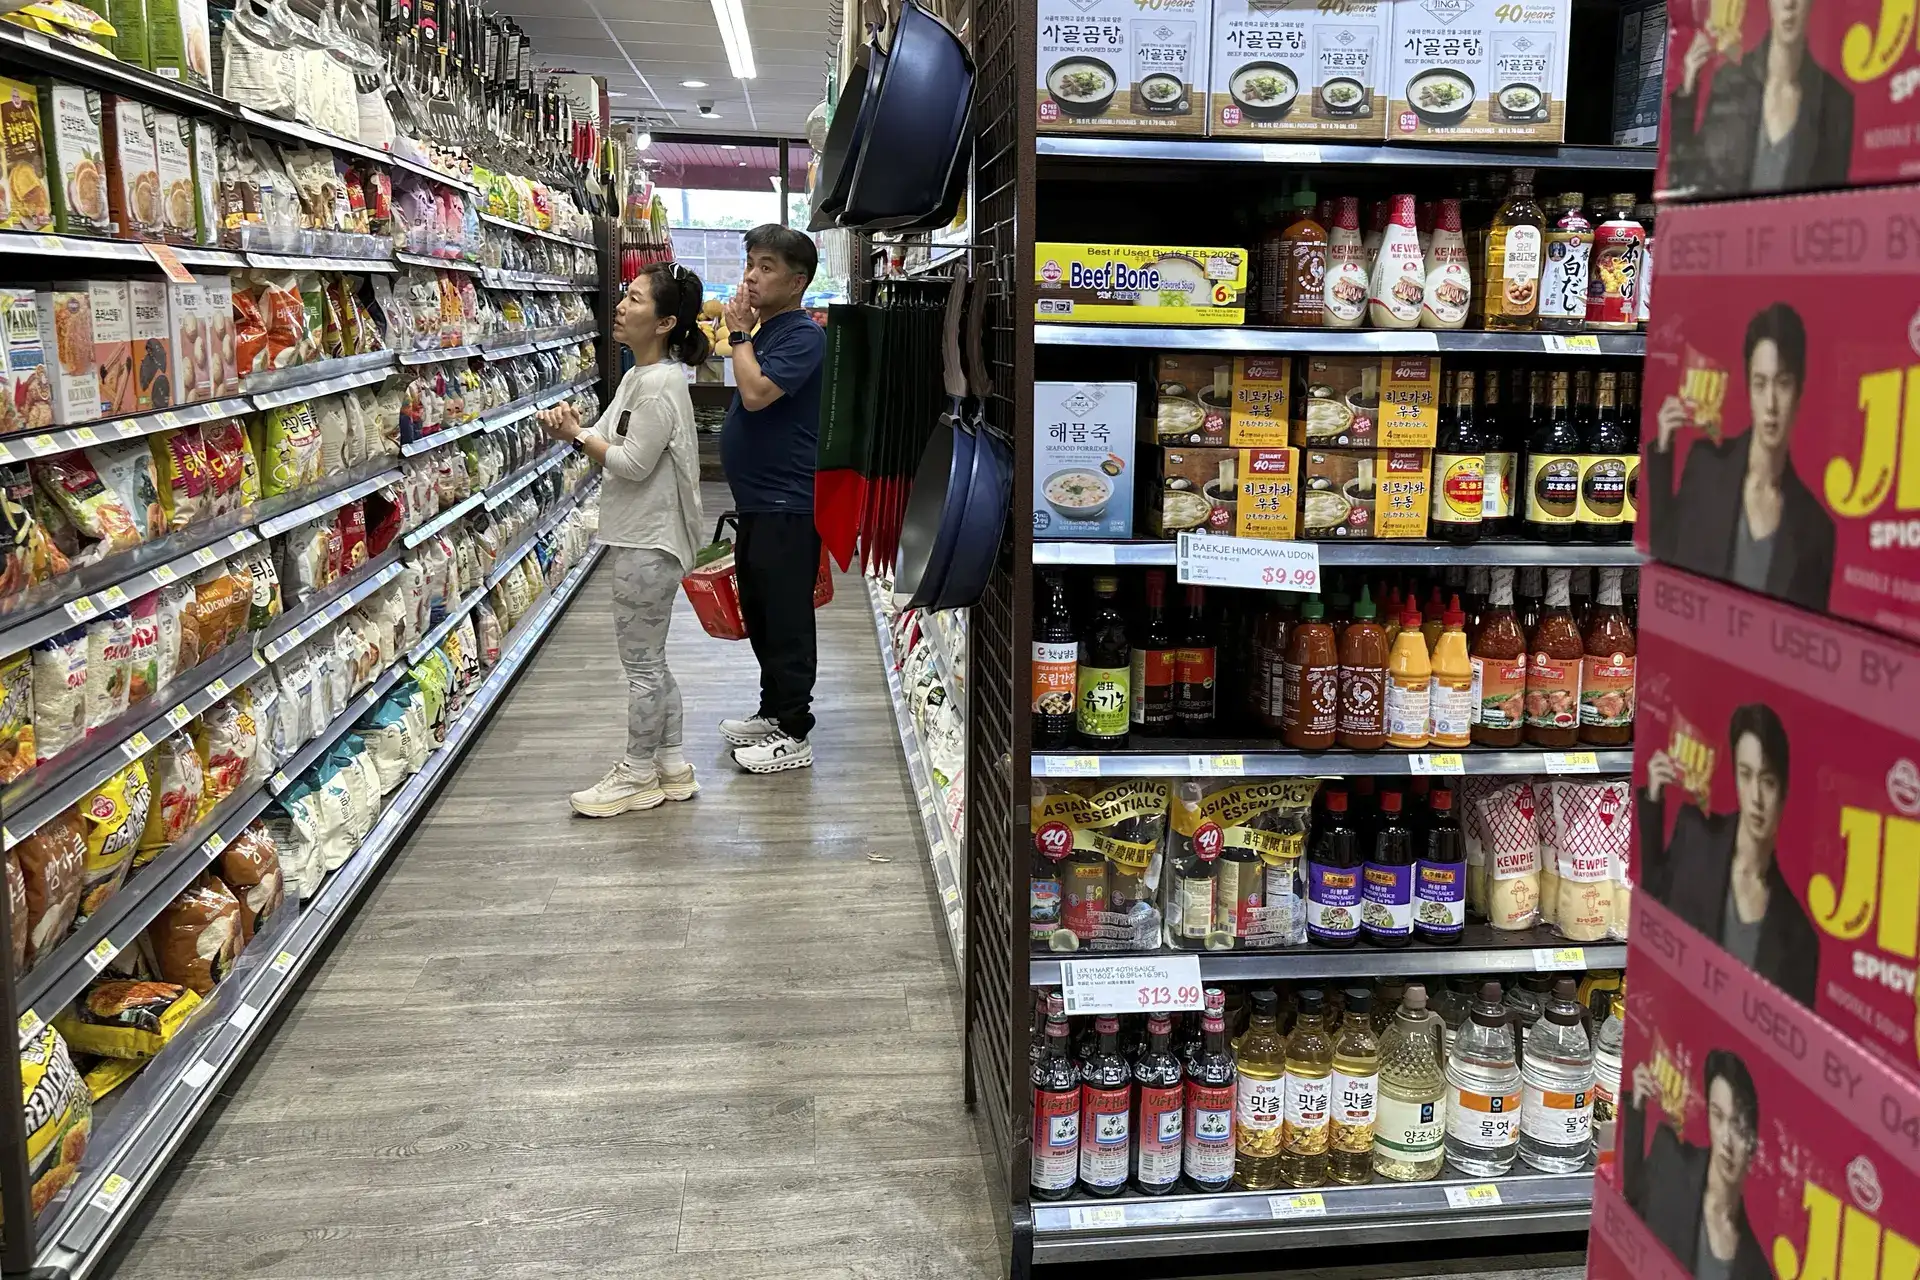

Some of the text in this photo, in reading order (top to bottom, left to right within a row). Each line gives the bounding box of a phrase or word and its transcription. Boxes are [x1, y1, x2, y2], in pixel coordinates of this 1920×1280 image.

[1345, 4, 1378, 16] years
[1434, 0, 1460, 8] JINGA
[1494, 4, 1556, 24] 40 years
[1043, 25, 1121, 45] 사골곰탕
[1227, 30, 1304, 49] 사골곰탕
[1404, 38, 1480, 57] 사골곰탕
[1138, 49, 1188, 61] 사골곰탕
[1320, 53, 1370, 65] 사골곰탕
[1497, 59, 1546, 71] 사골곰탕
[1041, 104, 1047, 115] 6
[1223, 108, 1230, 120] 6
[1400, 115, 1407, 126] 6
[1516, 242, 1532, 250] 요리
[1668, 212, 1920, 271] BEST IF USED BY
[1087, 247, 1110, 256] Best
[1113, 247, 1121, 256] if
[1122, 248, 1150, 258] Used
[1152, 250, 1165, 259] By
[1168, 250, 1181, 258] 16
[1508, 252, 1537, 262] 올리고당
[1070, 261, 1160, 290] Beef Bone
[1161, 280, 1195, 292] Flavored Soup
[1561, 255, 1583, 312] 白だし
[1214, 286, 1226, 303] 6
[1248, 367, 1262, 377] 40
[1395, 368, 1409, 378] 40
[1239, 390, 1284, 404] 히모카와
[1386, 391, 1432, 404] 히모카와
[1070, 400, 1089, 408] JINGA
[1250, 404, 1273, 417] 우동
[1396, 405, 1420, 418] 우동
[1239, 420, 1280, 428] ひもかわうどん
[1387, 420, 1428, 428] ひもかわうどん
[1048, 421, 1111, 444] 해물죽
[1081, 445, 1109, 453] PORRIDGE
[1253, 460, 1268, 470] 40
[1390, 459, 1403, 470] 40
[1245, 483, 1292, 496] 히모카와
[1382, 481, 1425, 494] 히모카와
[1256, 498, 1280, 511] 우동
[1390, 496, 1413, 509] 우동
[1245, 513, 1288, 521] ひもかわうどん
[1193, 543, 1315, 560] BAEKJE HIMOKAWA UDON
[1262, 567, 1316, 586] $9.99
[1654, 580, 1904, 691] BEST IF USED BY
[1097, 681, 1115, 691] 샘표
[1082, 690, 1127, 712] 유기농
[1043, 781, 1167, 817] ASIAN COOKING
[1199, 790, 1242, 818] ASIAN
[1073, 797, 1162, 824] ESSENTIALS
[1041, 829, 1067, 847] 40
[1200, 831, 1218, 848] 40
[1496, 851, 1534, 868] KEWPIE
[1572, 857, 1608, 870] KEWPIE
[1138, 986, 1200, 1007] $13.99
[1638, 909, 1861, 1099] BEST IF USED BY
[1251, 1095, 1280, 1113] 맛술
[1298, 1093, 1327, 1111] 맛술
[1344, 1091, 1373, 1109] 맛술
[1479, 1120, 1510, 1137] 물엿
[1564, 1115, 1589, 1133] 물엿
